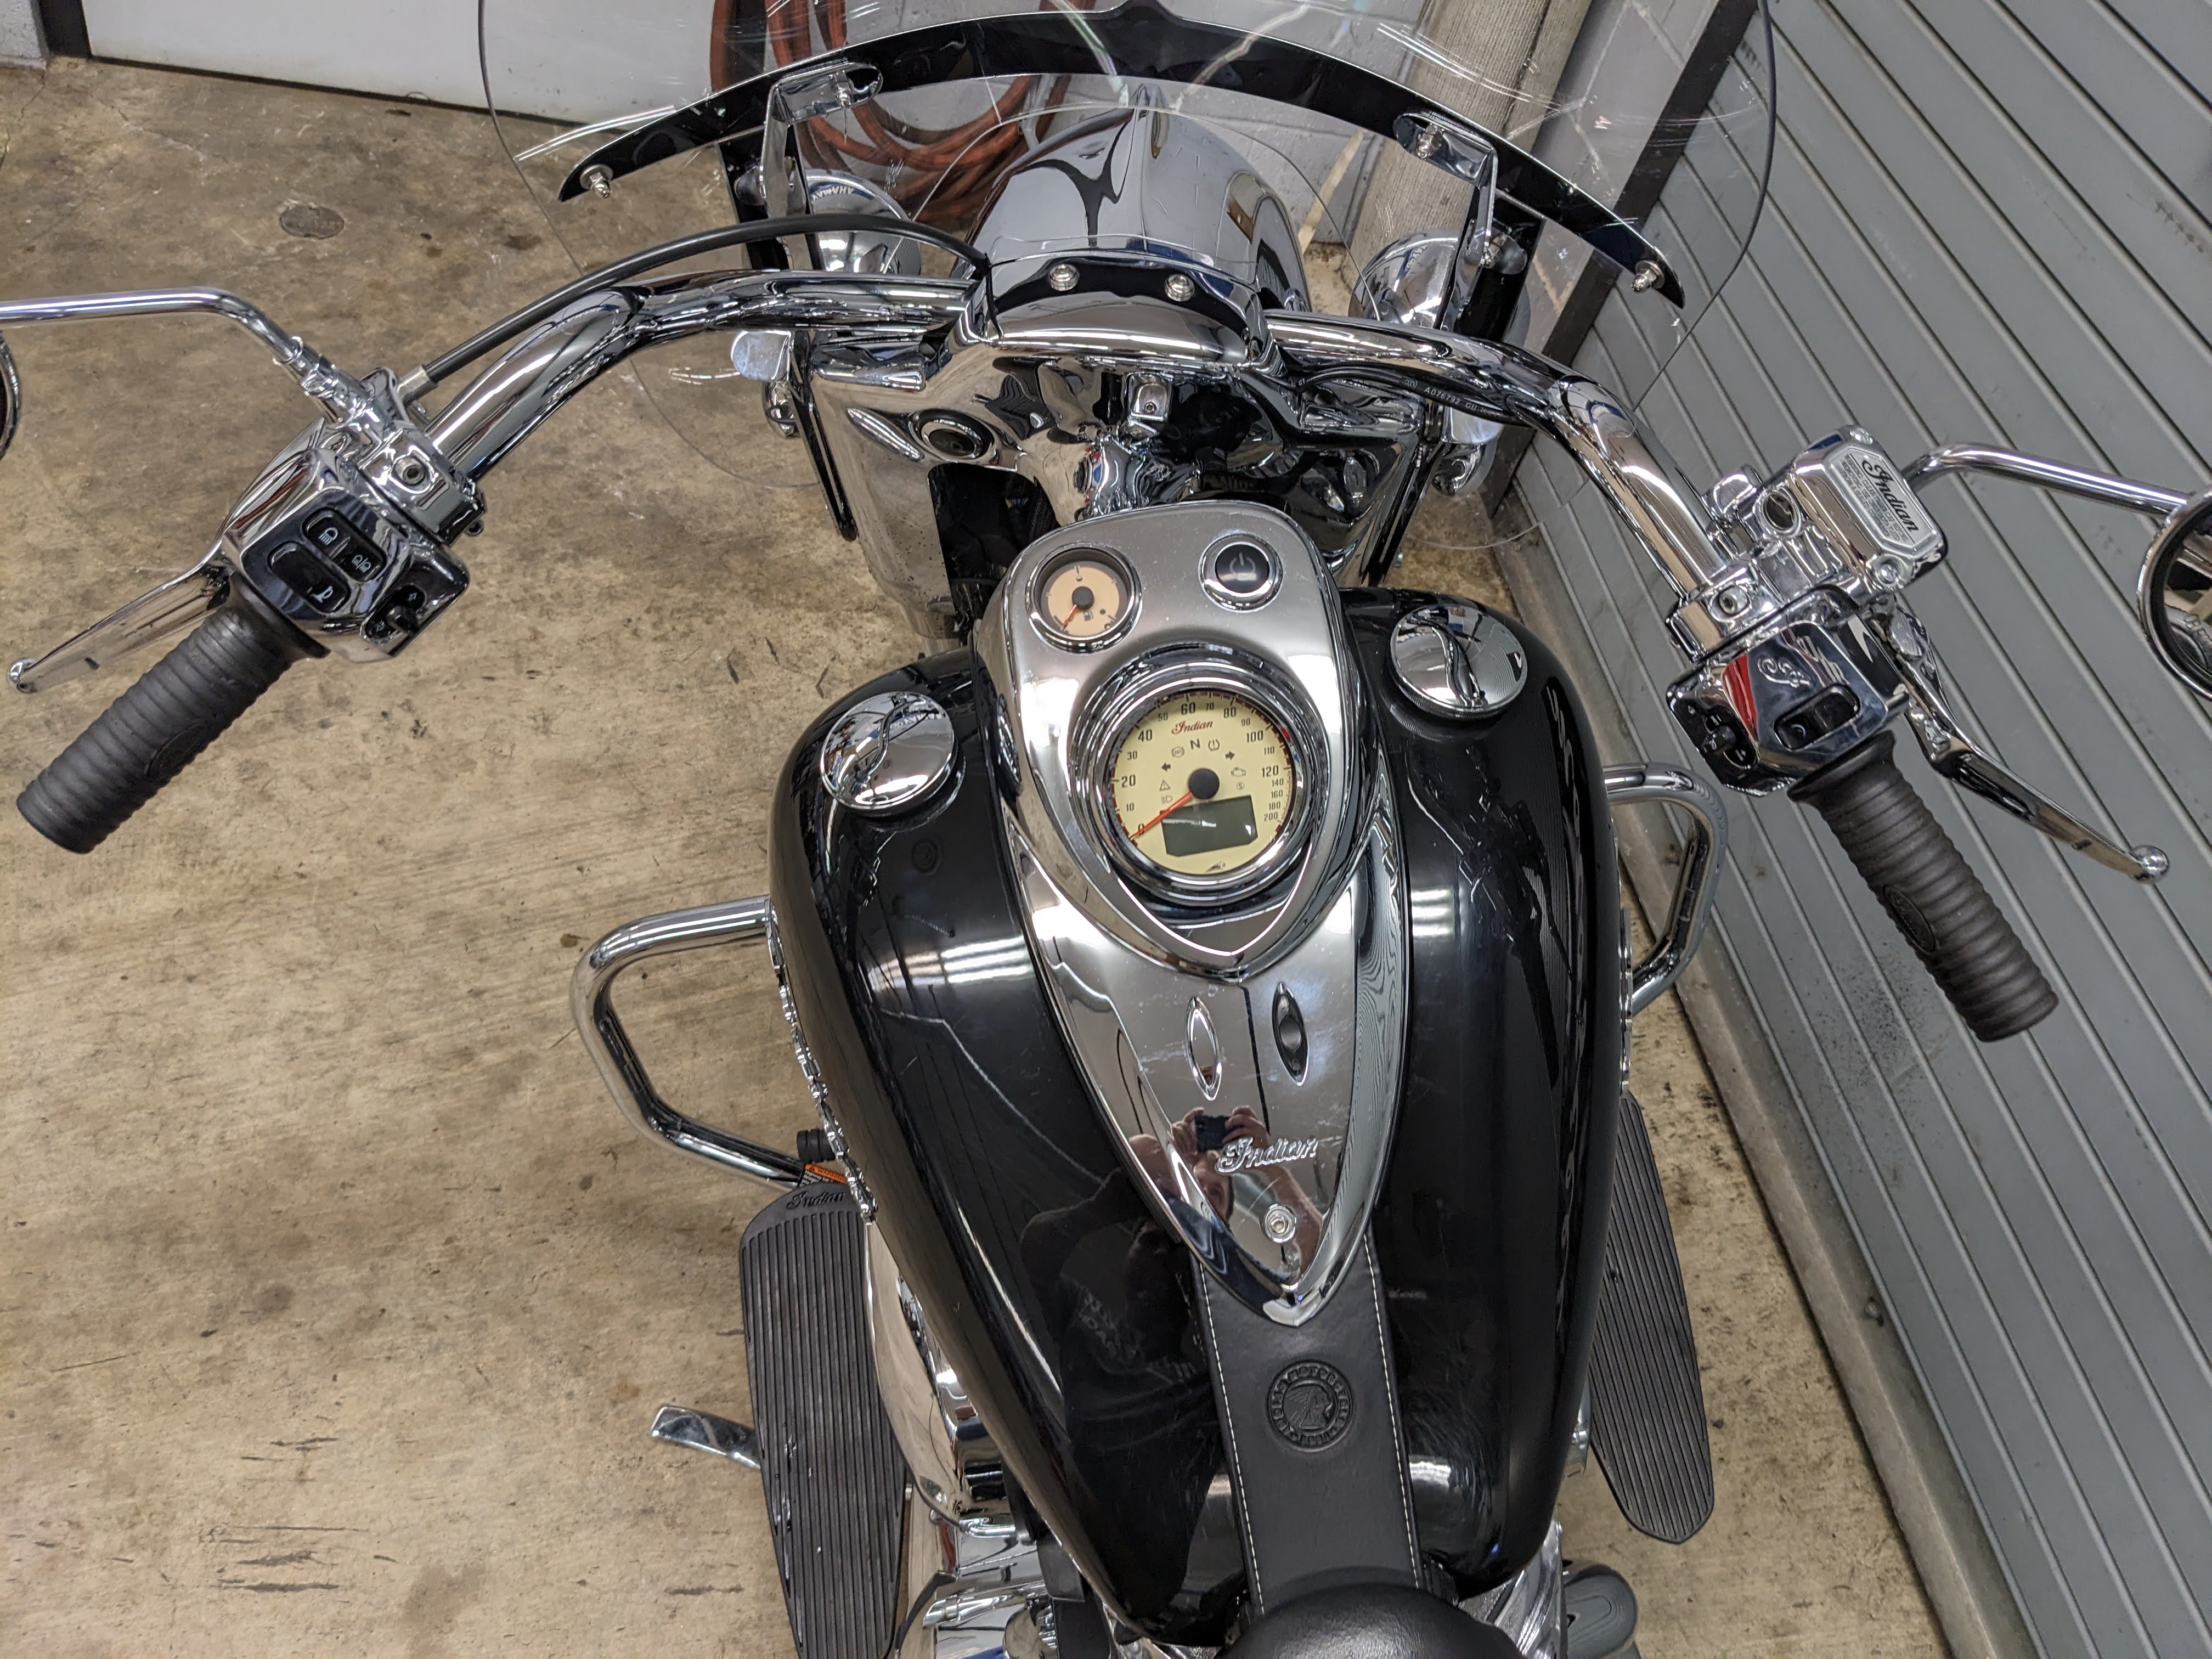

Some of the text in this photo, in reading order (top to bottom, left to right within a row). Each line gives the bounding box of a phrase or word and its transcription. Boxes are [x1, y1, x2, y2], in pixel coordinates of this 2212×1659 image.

[1424, 387, 1460, 405] A076792
[1862, 460, 1918, 532] Indian
[1181, 702, 1196, 715] 60
[1206, 702, 1215, 711] 70
[1158, 713, 1169, 722] 50
[1223, 707, 1237, 719] 80
[1171, 720, 1214, 735] Indian
[1241, 718, 1251, 727] 90
[1138, 729, 1153, 742] 40
[1246, 730, 1263, 744] 100
[1190, 738, 1200, 750] N
[1127, 751, 1138, 760] 30
[1263, 746, 1275, 755] 110
[1261, 765, 1279, 778] 120
[1121, 775, 1136, 788] 20
[1272, 778, 1284, 787] 140
[1271, 789, 1283, 798] 160
[1126, 803, 1135, 811] 10
[1268, 802, 1281, 810] 180
[1263, 812, 1278, 821] 200
[1215, 1137, 1318, 1173] Indian
[786, 1191, 845, 1209] Indian
